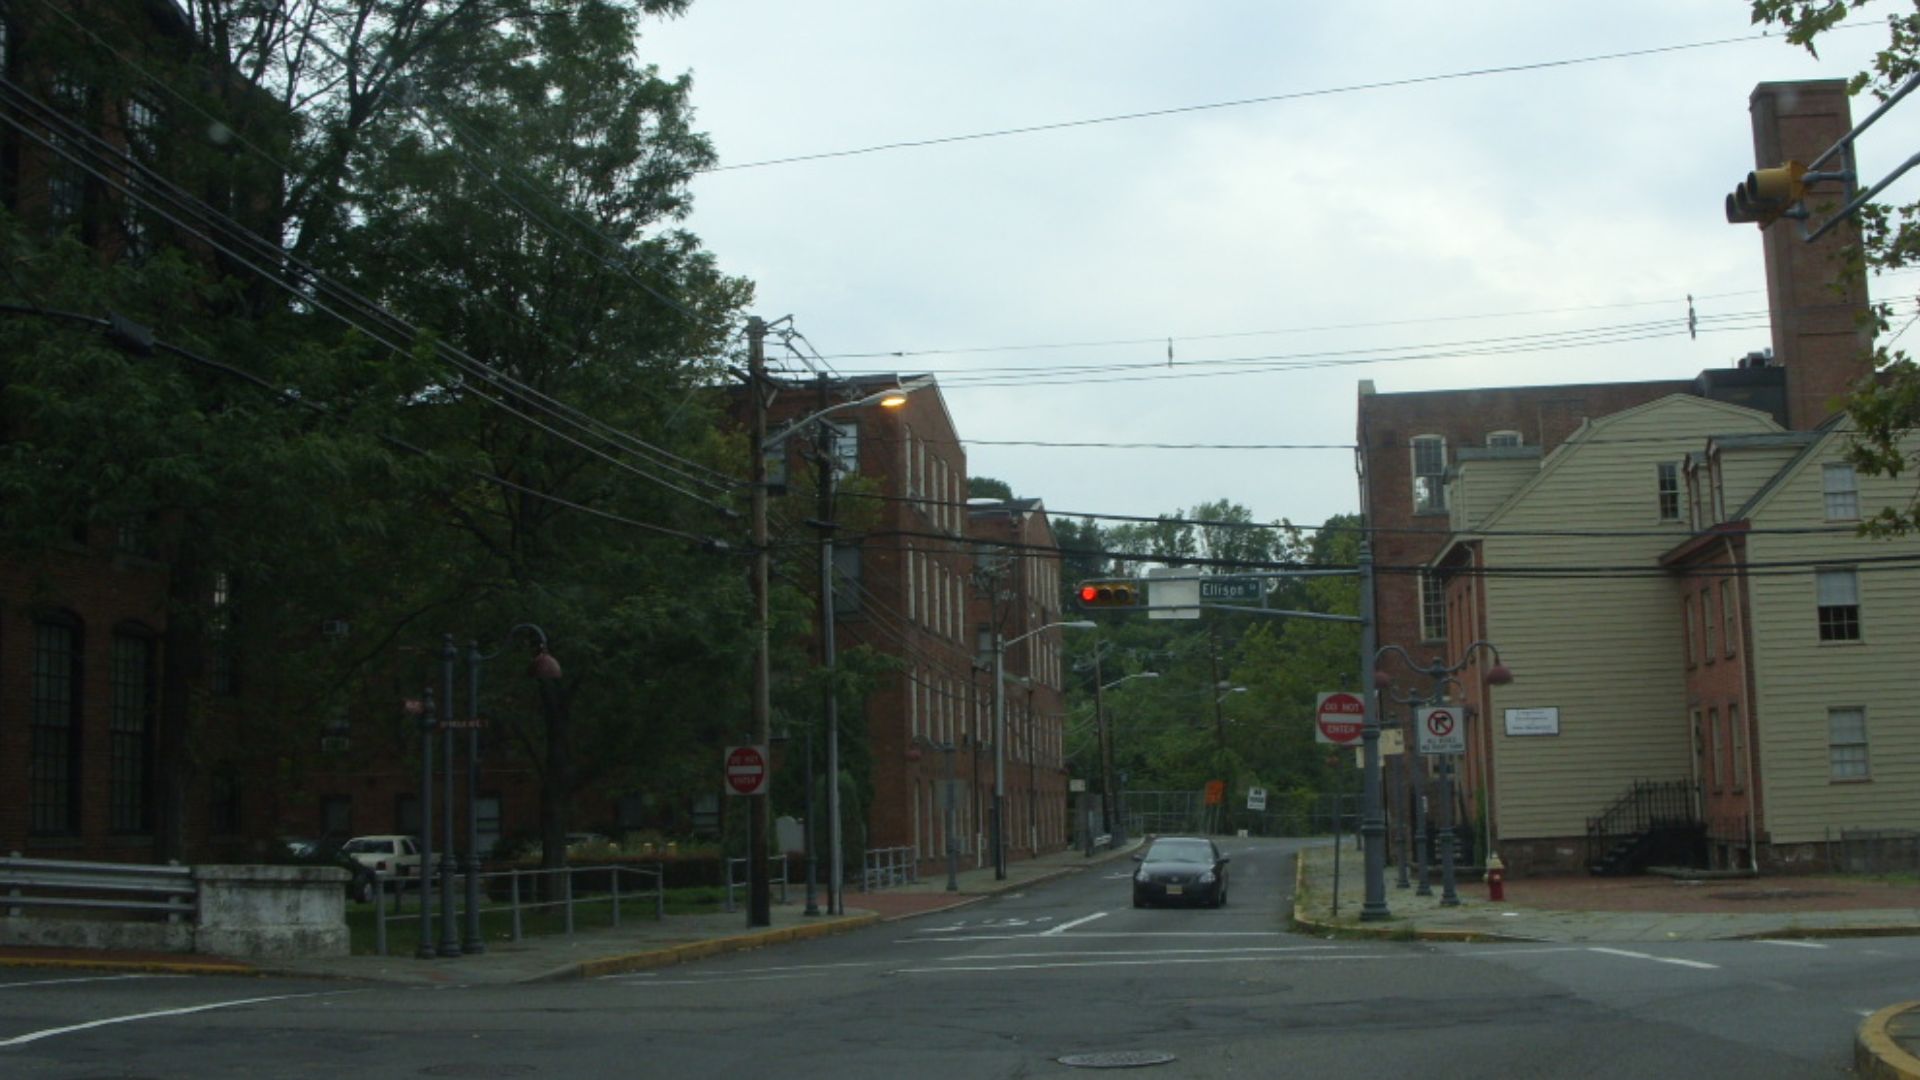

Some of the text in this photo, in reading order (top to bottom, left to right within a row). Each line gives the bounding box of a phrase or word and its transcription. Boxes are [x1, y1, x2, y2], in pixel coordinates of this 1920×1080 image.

[1202, 583, 1244, 596] Ellison
[1324, 703, 1359, 711] DO NOT
[1327, 724, 1356, 734] ENTER
